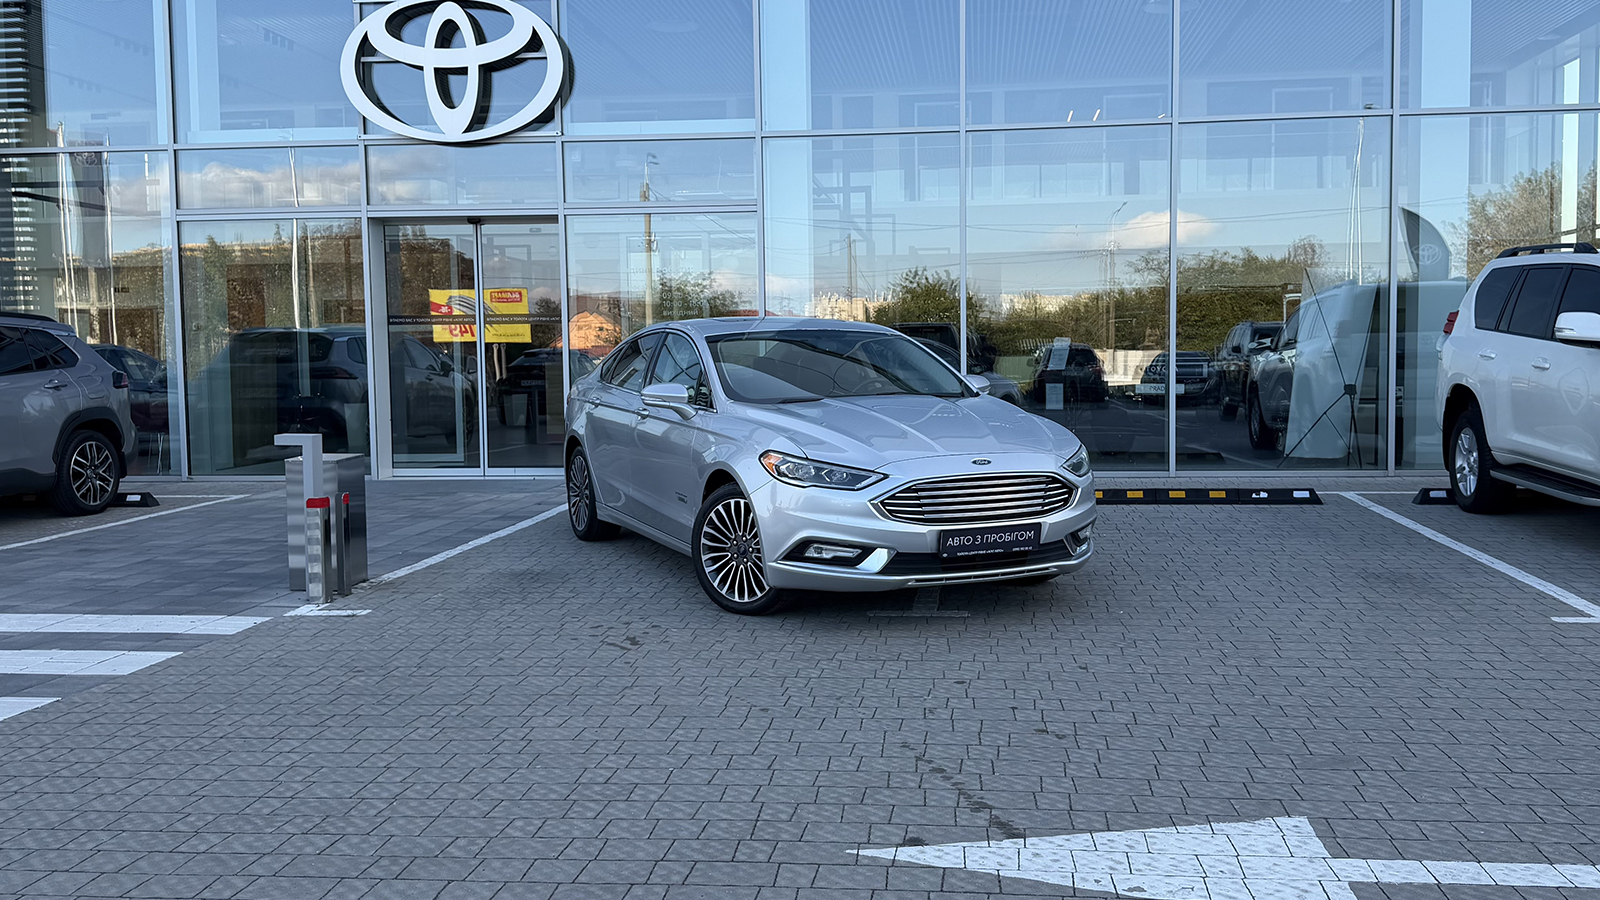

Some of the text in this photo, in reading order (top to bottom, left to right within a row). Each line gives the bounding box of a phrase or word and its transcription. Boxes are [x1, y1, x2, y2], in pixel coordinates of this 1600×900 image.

[946, 530, 1035, 546] АВТО З ПРОБІГОМ
